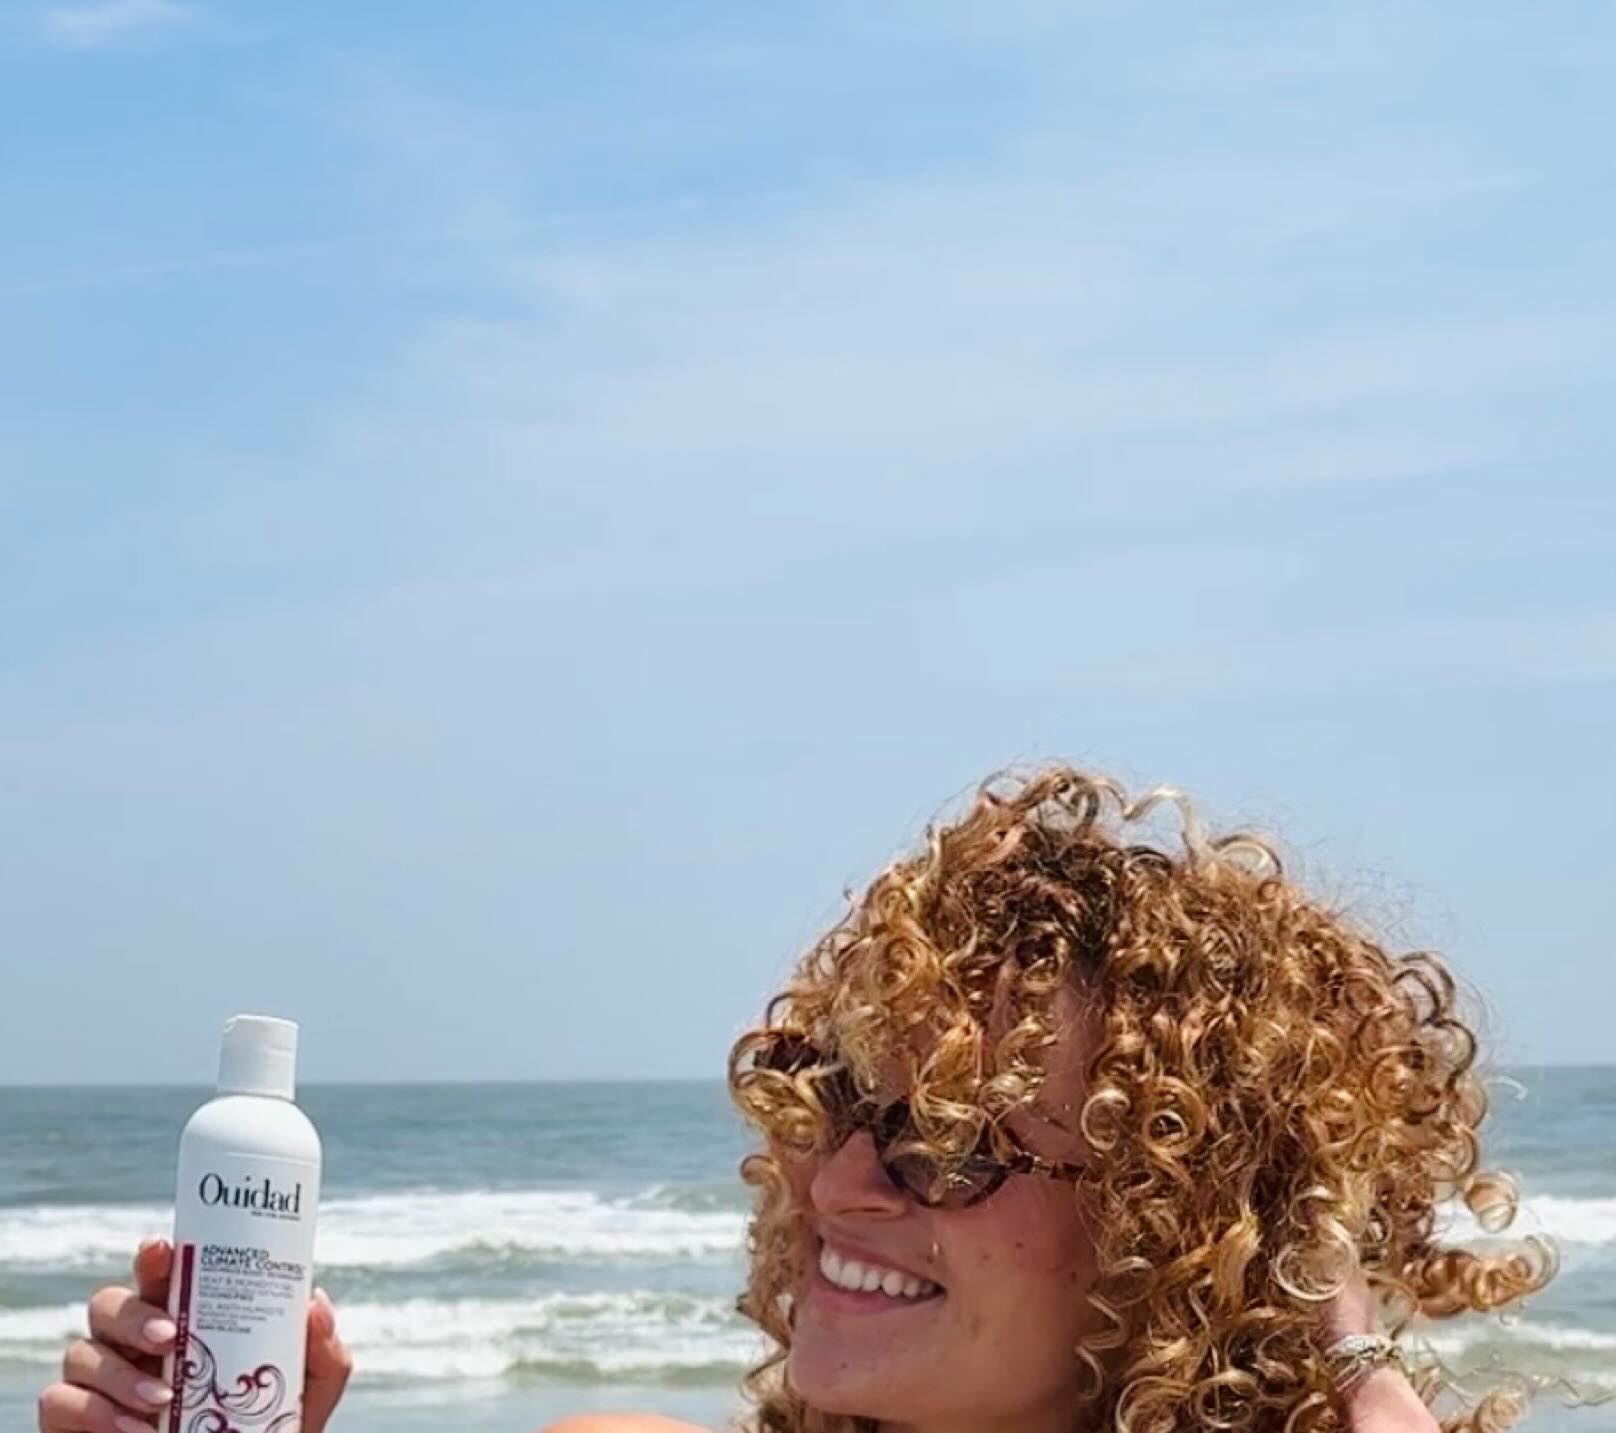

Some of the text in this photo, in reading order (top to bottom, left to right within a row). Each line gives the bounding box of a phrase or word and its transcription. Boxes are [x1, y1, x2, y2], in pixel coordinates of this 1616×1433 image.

[199, 1172, 302, 1214] Ouidad
[202, 1244, 270, 1259] ADVANCED
[200, 1255, 251, 1269] CLIMATE
